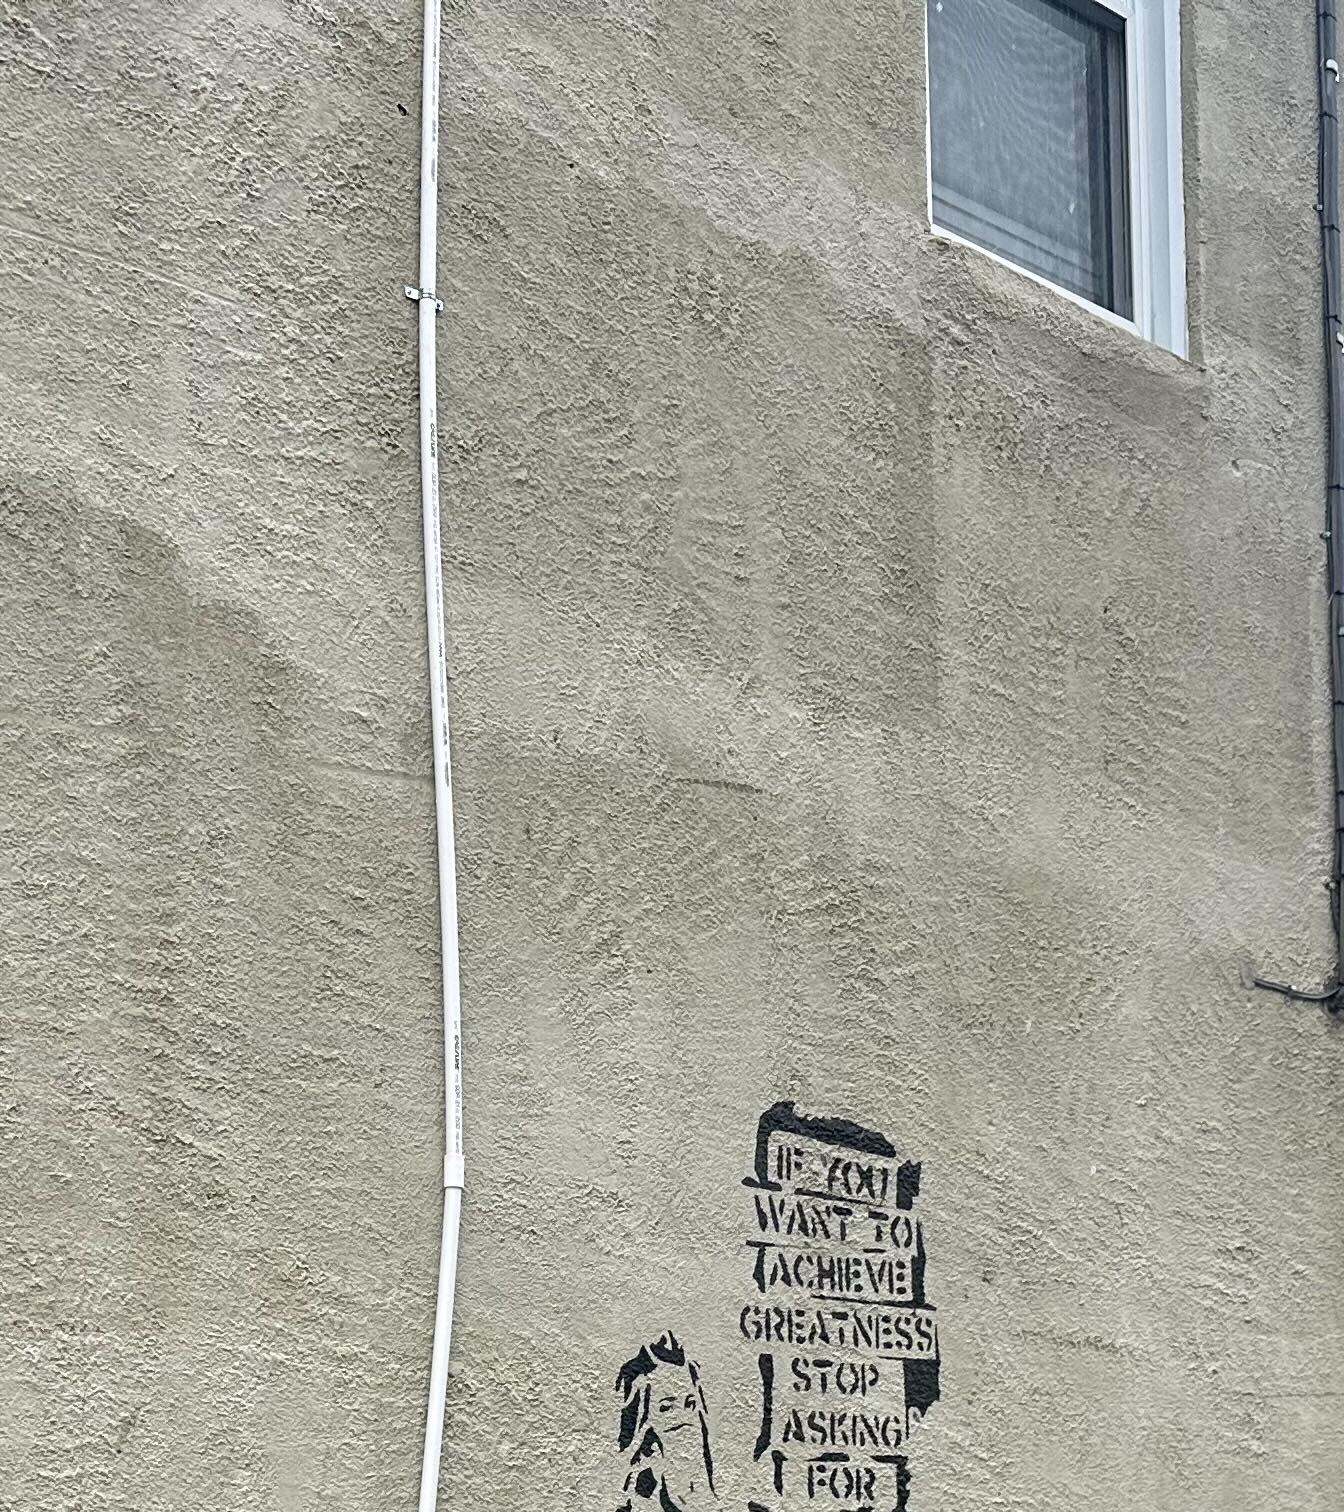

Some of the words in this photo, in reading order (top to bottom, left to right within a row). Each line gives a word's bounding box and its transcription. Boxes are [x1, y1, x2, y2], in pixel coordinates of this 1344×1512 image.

[776, 1144, 805, 1181] IF
[820, 1152, 889, 1201] YOU
[754, 1193, 854, 1242] WANT
[867, 1210, 913, 1249] TO
[769, 1252, 907, 1295] ACHIEVE
[739, 1304, 933, 1352] GREATNESS
[791, 1356, 880, 1397] STOP
[782, 1408, 903, 1449] ASKING
[807, 1463, 877, 1502] FOR
